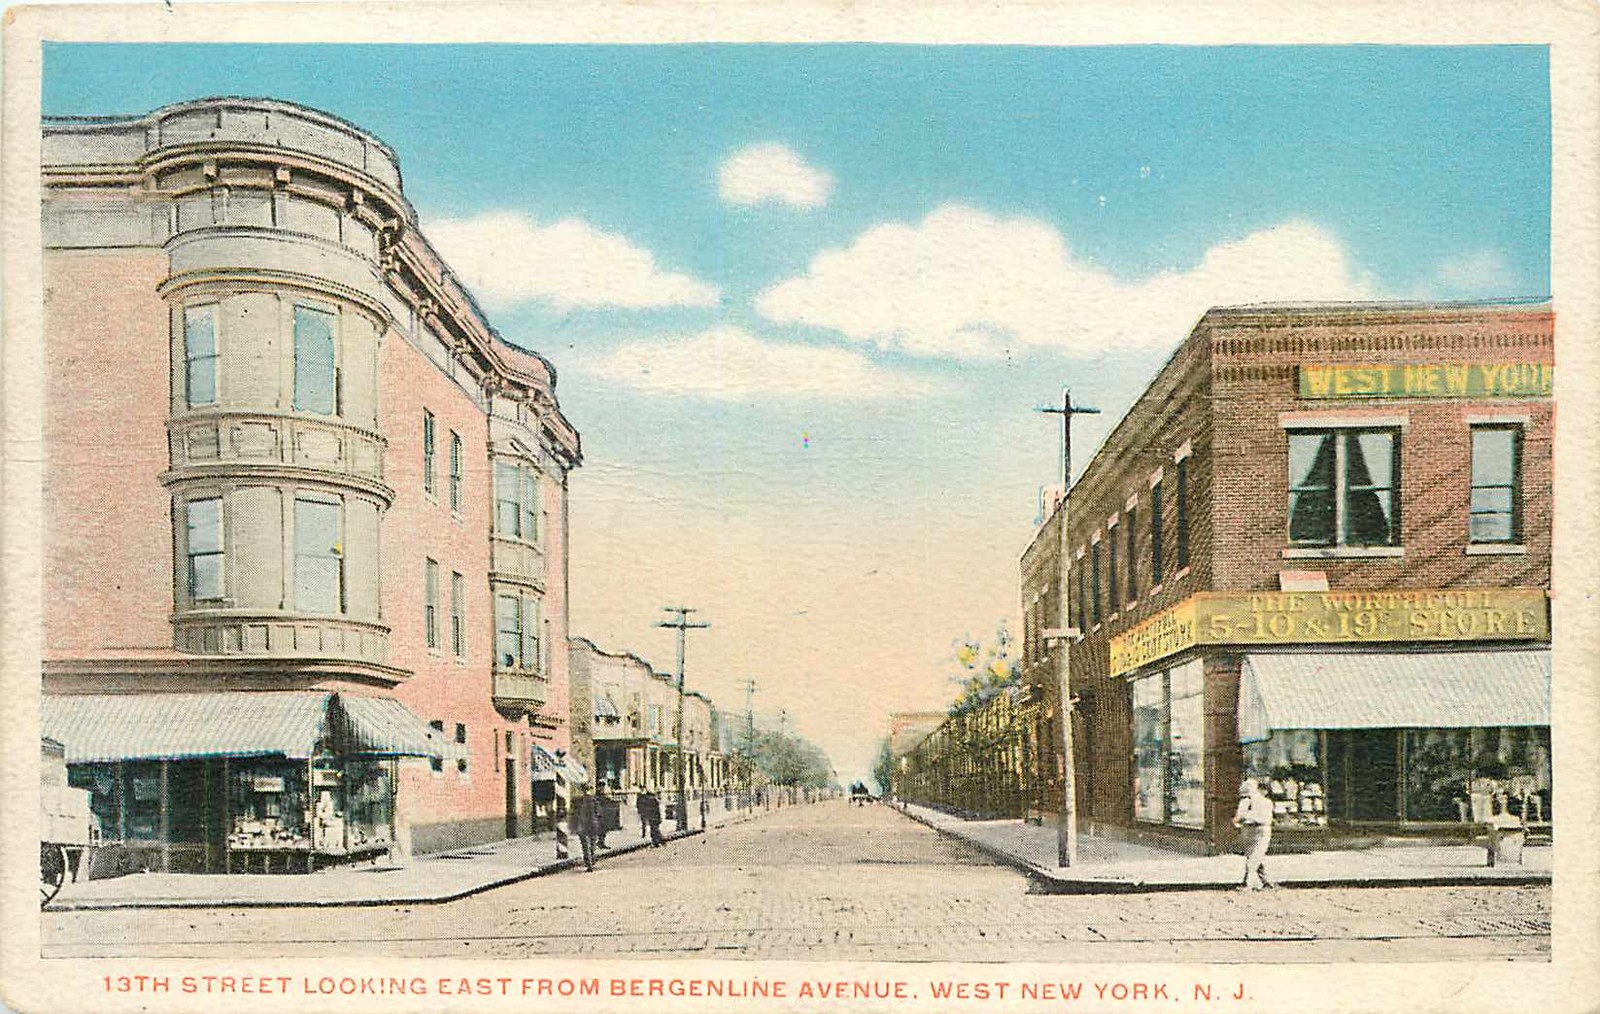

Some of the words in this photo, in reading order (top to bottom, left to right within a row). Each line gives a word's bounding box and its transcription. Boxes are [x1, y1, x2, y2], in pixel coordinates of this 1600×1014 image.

[1306, 366, 1390, 394] WEST
[1403, 365, 1469, 394] NEW
[1250, 593, 1306, 613] THE
[1304, 617, 1328, 640] &
[1409, 608, 1537, 639] STORE
